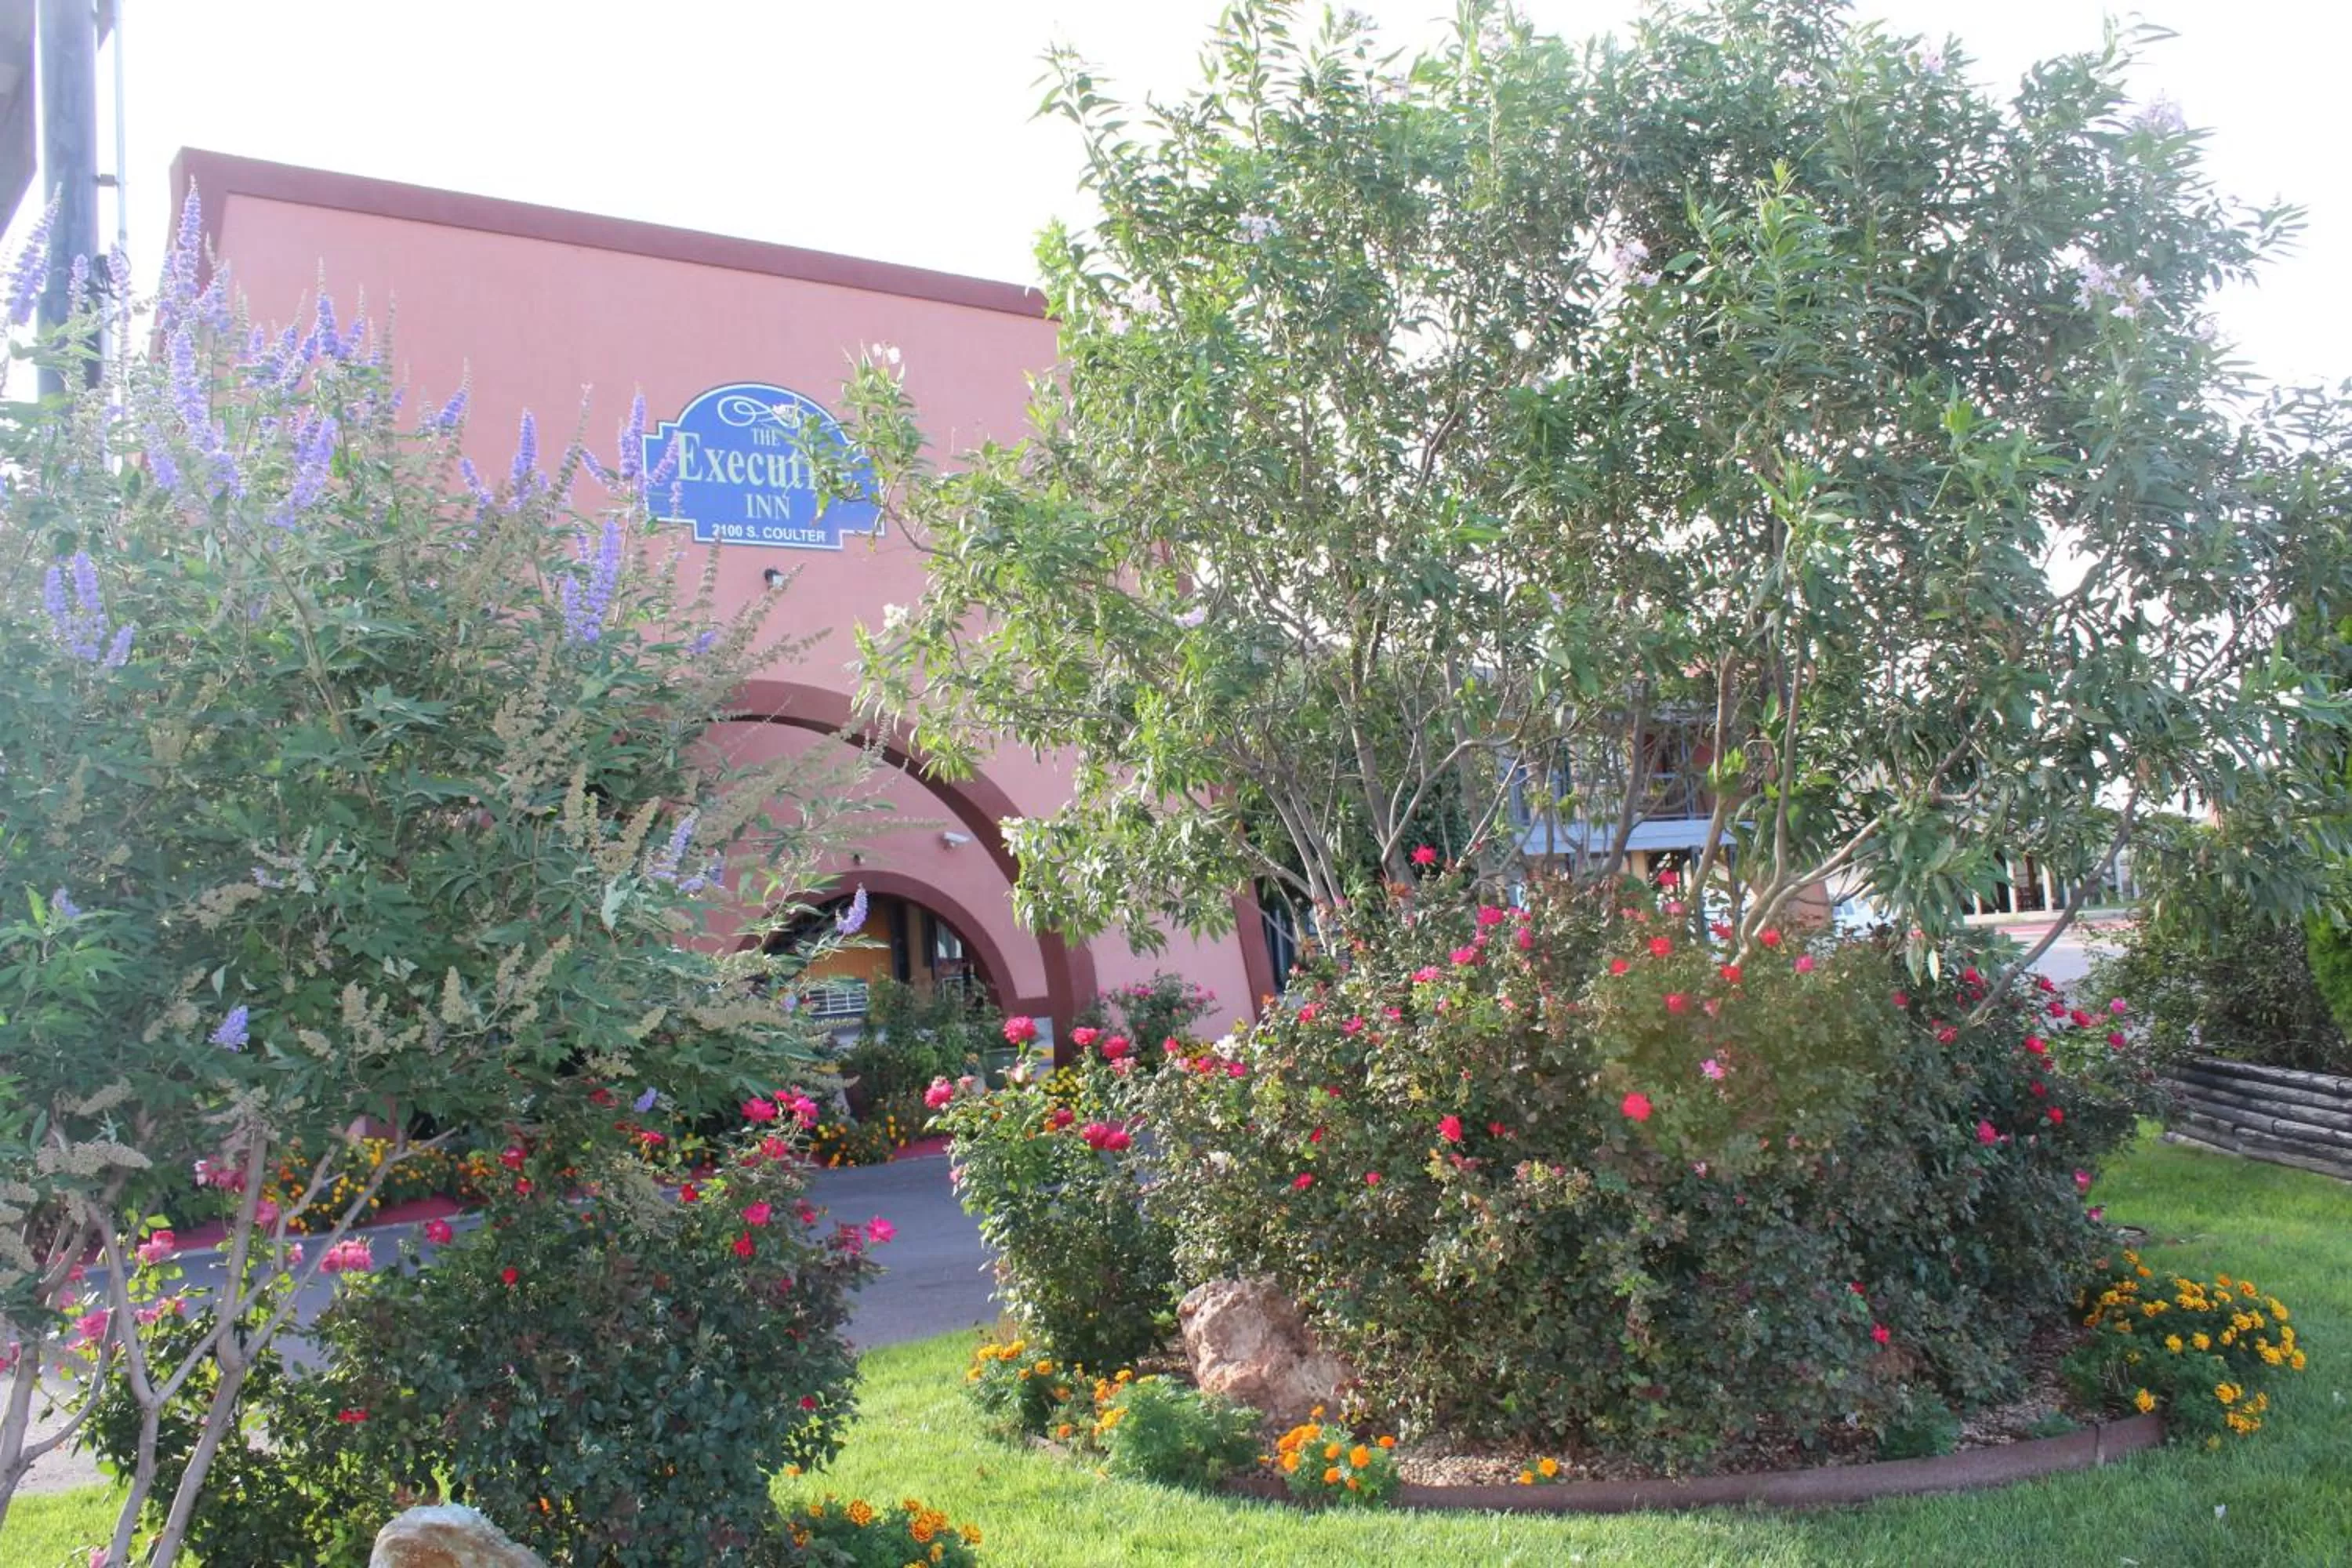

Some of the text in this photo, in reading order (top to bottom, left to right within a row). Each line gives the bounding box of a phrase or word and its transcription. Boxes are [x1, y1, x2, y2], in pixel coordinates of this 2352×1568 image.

[751, 426, 781, 446] THE
[676, 432, 852, 492] Executi
[744, 493, 791, 521] INN
[712, 523, 826, 543] 2100 S. COULTER
